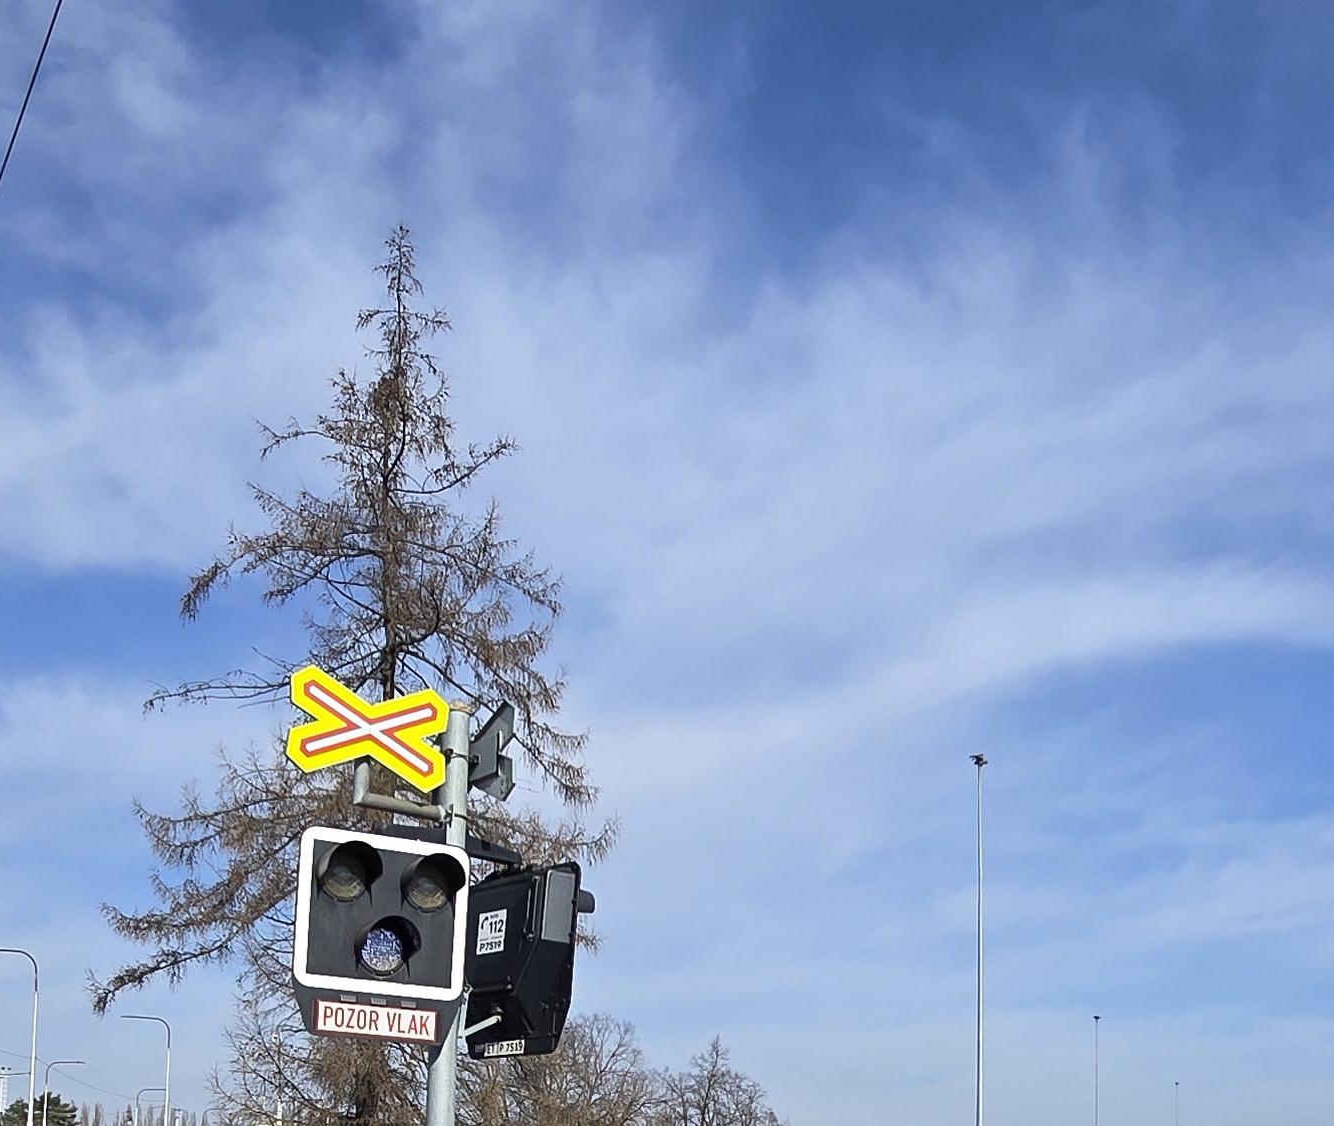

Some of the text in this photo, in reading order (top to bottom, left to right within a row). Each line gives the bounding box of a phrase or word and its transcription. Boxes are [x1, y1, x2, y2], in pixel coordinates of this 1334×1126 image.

[489, 919, 504, 935] 112
[479, 940, 502, 952] P7519
[323, 1006, 429, 1036] POZOR VLAK
